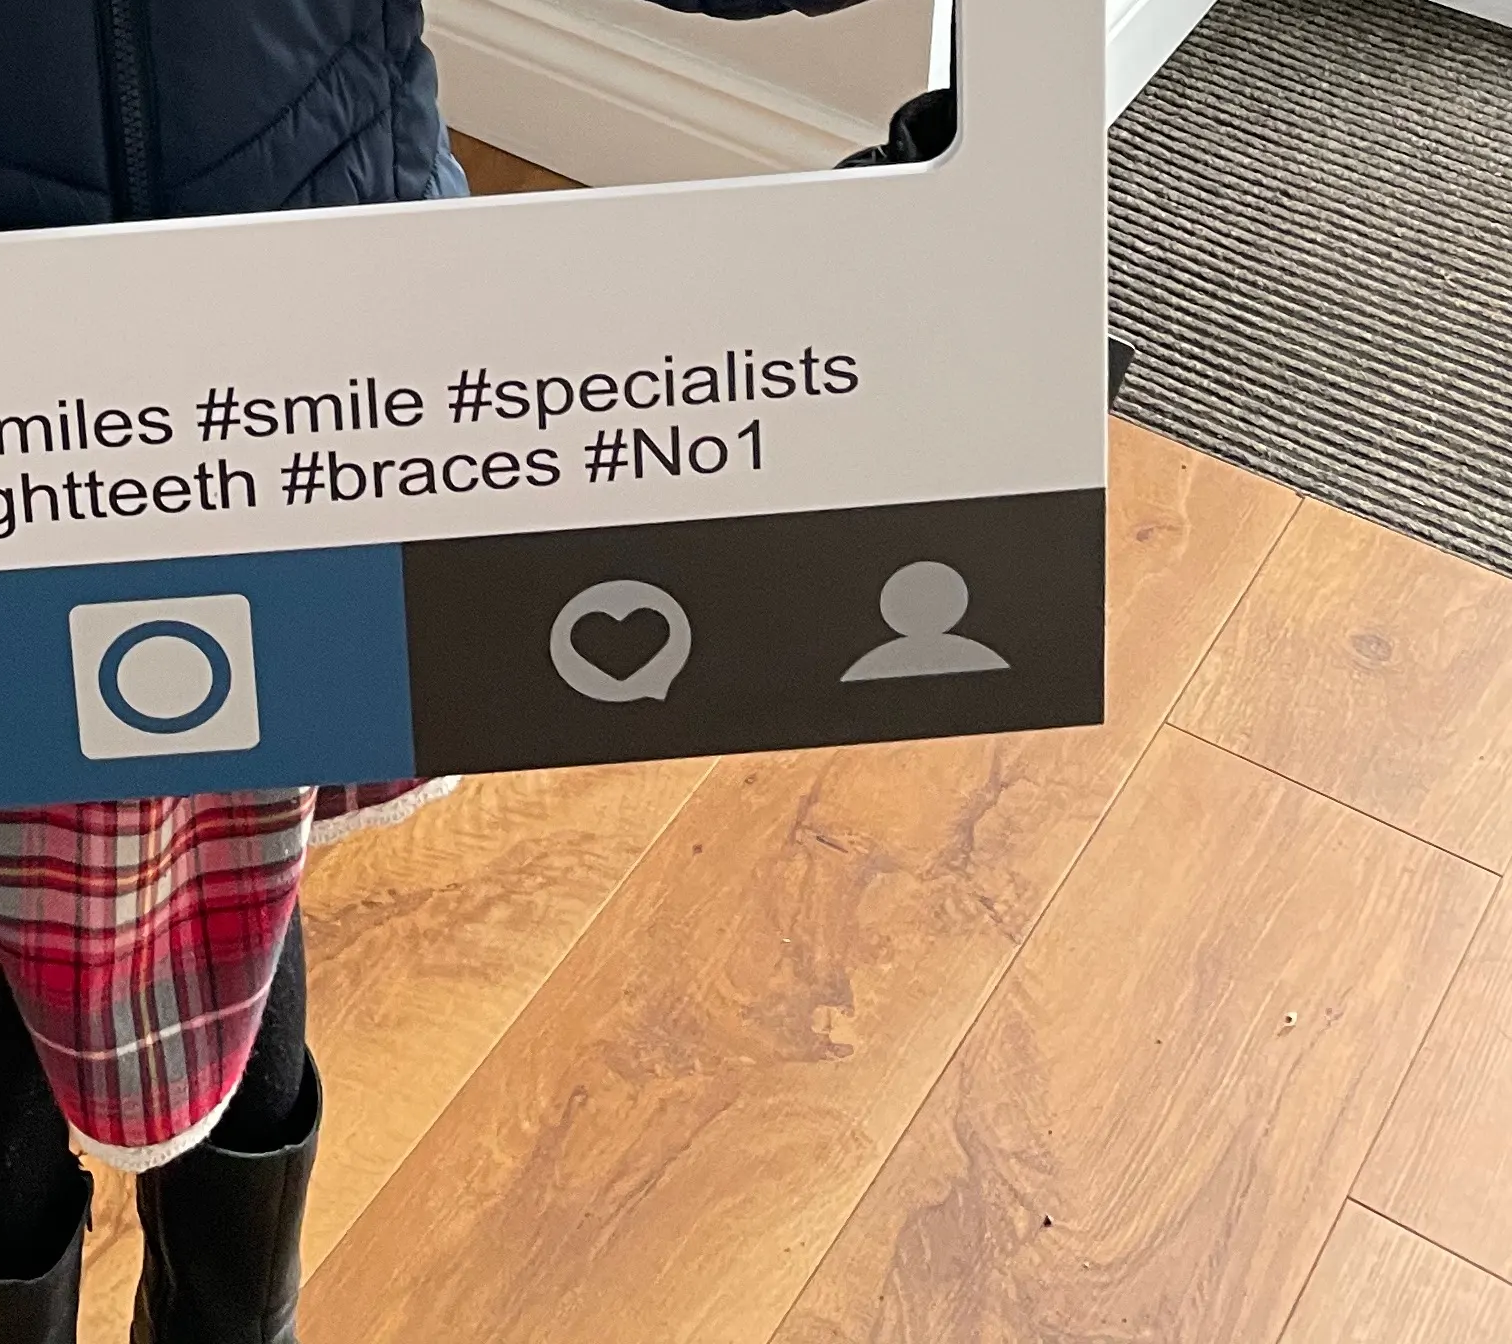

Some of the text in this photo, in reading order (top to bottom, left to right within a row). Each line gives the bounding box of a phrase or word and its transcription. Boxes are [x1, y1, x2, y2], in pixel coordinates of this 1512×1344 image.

[196, 377, 425, 443] #smile
[447, 345, 860, 431] #specialists
[280, 448, 562, 507] #braces
[584, 419, 762, 484] #No1
